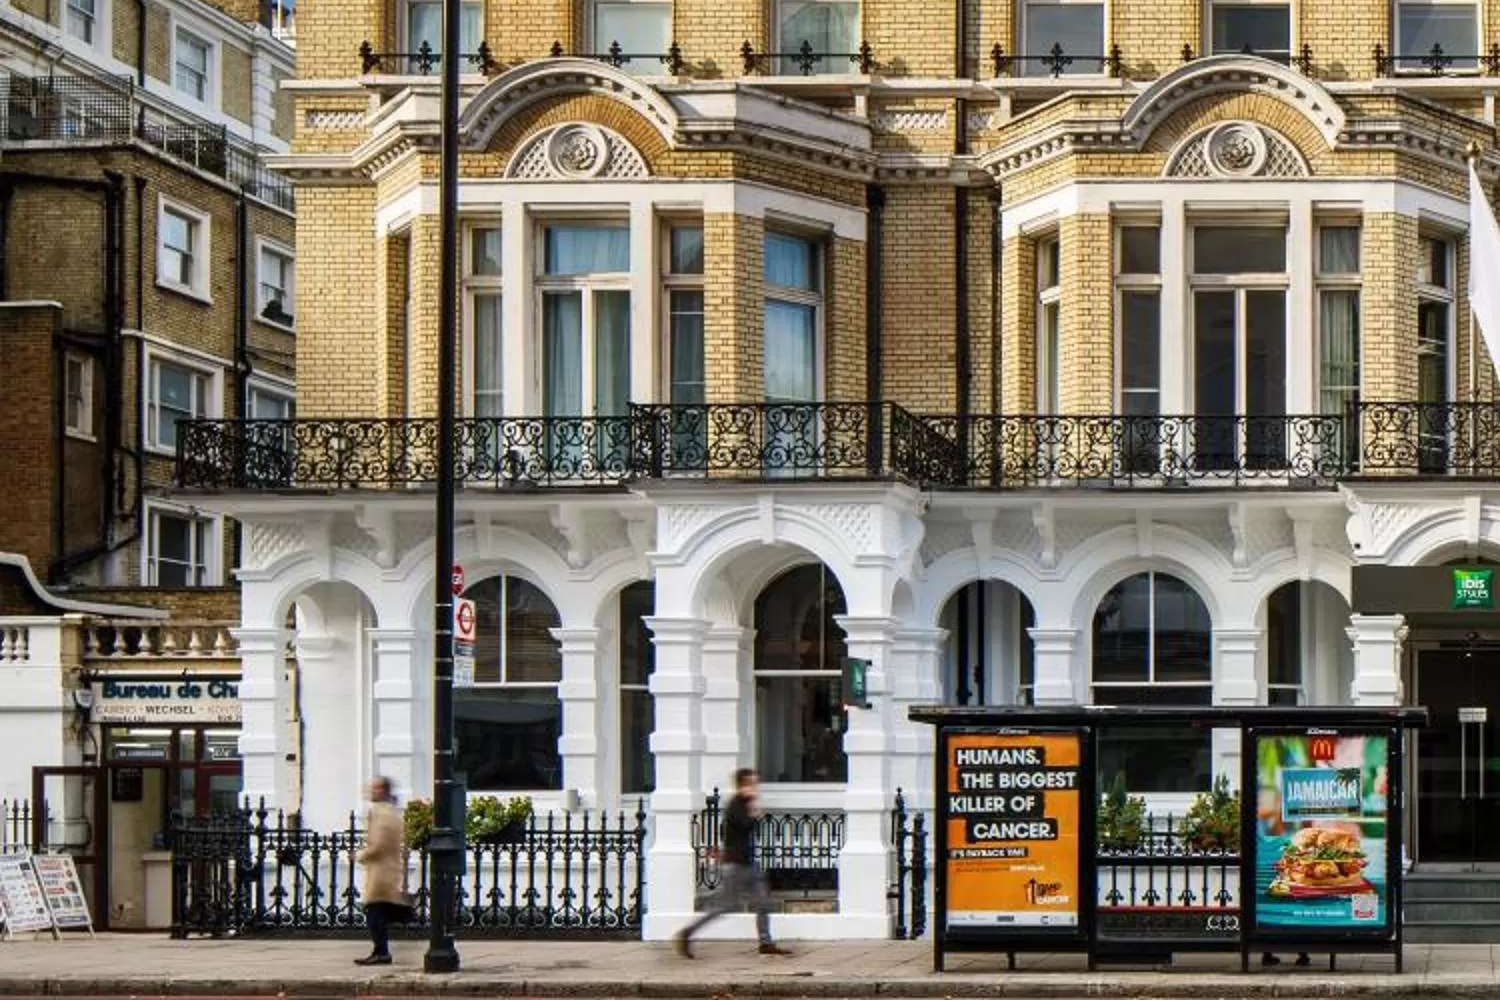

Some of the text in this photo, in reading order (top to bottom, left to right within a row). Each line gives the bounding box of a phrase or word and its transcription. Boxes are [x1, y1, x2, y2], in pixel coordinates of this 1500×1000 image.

[1462, 576, 1485, 589] ibis
[102, 682, 171, 699] Bureau
[177, 682, 202, 699] de
[146, 705, 195, 715] WECHSEL
[957, 749, 1041, 765] HUMANS.
[962, 771, 1077, 789] THE BIGGEST
[1287, 779, 1358, 801] JAMAICAN
[950, 795, 1035, 813] KILLER OF
[973, 822, 1055, 839] CANCER.
